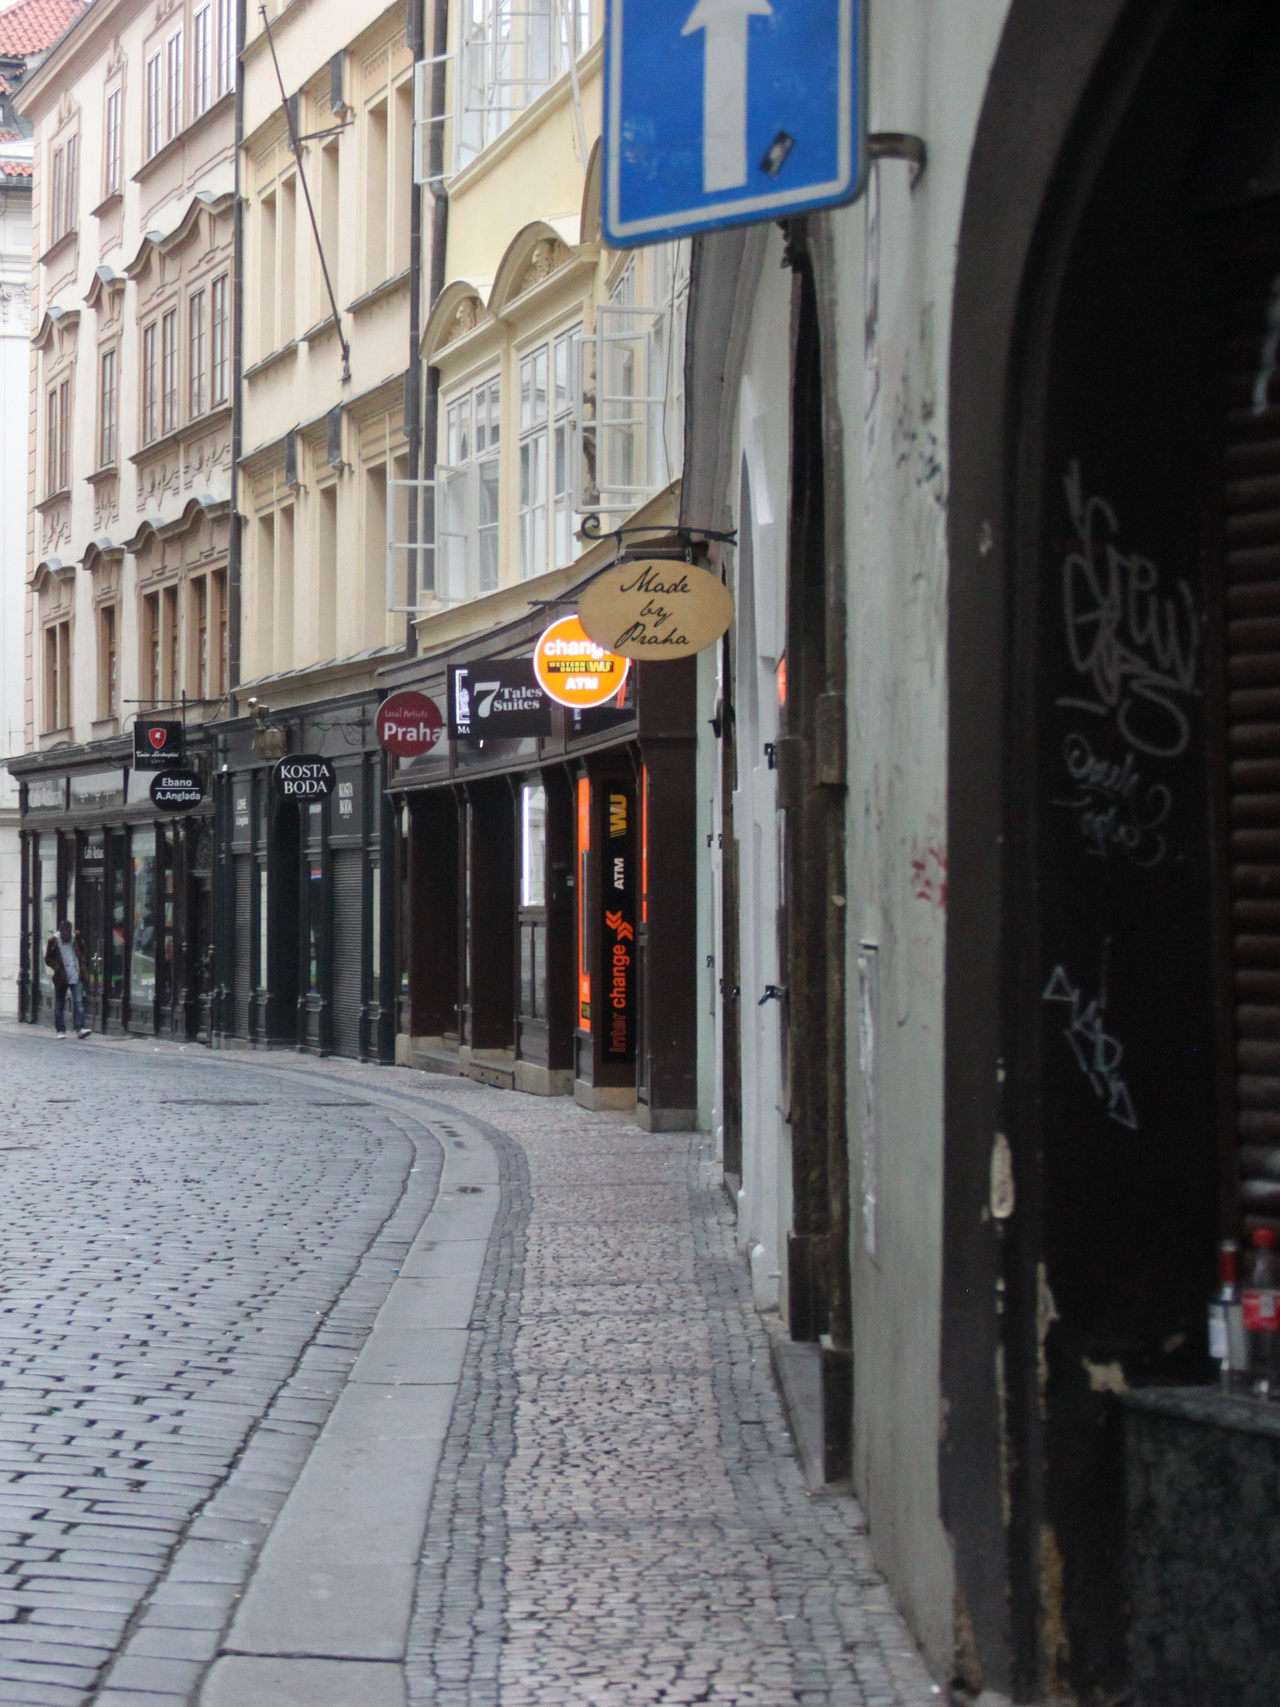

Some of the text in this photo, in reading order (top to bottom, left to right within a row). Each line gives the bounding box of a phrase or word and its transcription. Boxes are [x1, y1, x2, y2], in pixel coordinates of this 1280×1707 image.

[620, 565, 692, 594] Made
[639, 598, 674, 628] by
[614, 620, 689, 650] Praha
[544, 638, 612, 660] chang
[564, 676, 599, 690] ATM
[473, 681, 543, 718] 7 Tales
[493, 699, 541, 712] Suites
[384, 706, 429, 718] Local Artists
[384, 722, 442, 742] Praha
[280, 764, 330, 779] KOSTA
[161, 777, 193, 787] Ebano
[284, 780, 328, 795] BODA
[155, 791, 201, 802] A.Anglada
[613, 857, 625, 890] ATM
[609, 944, 631, 1053] inter change
